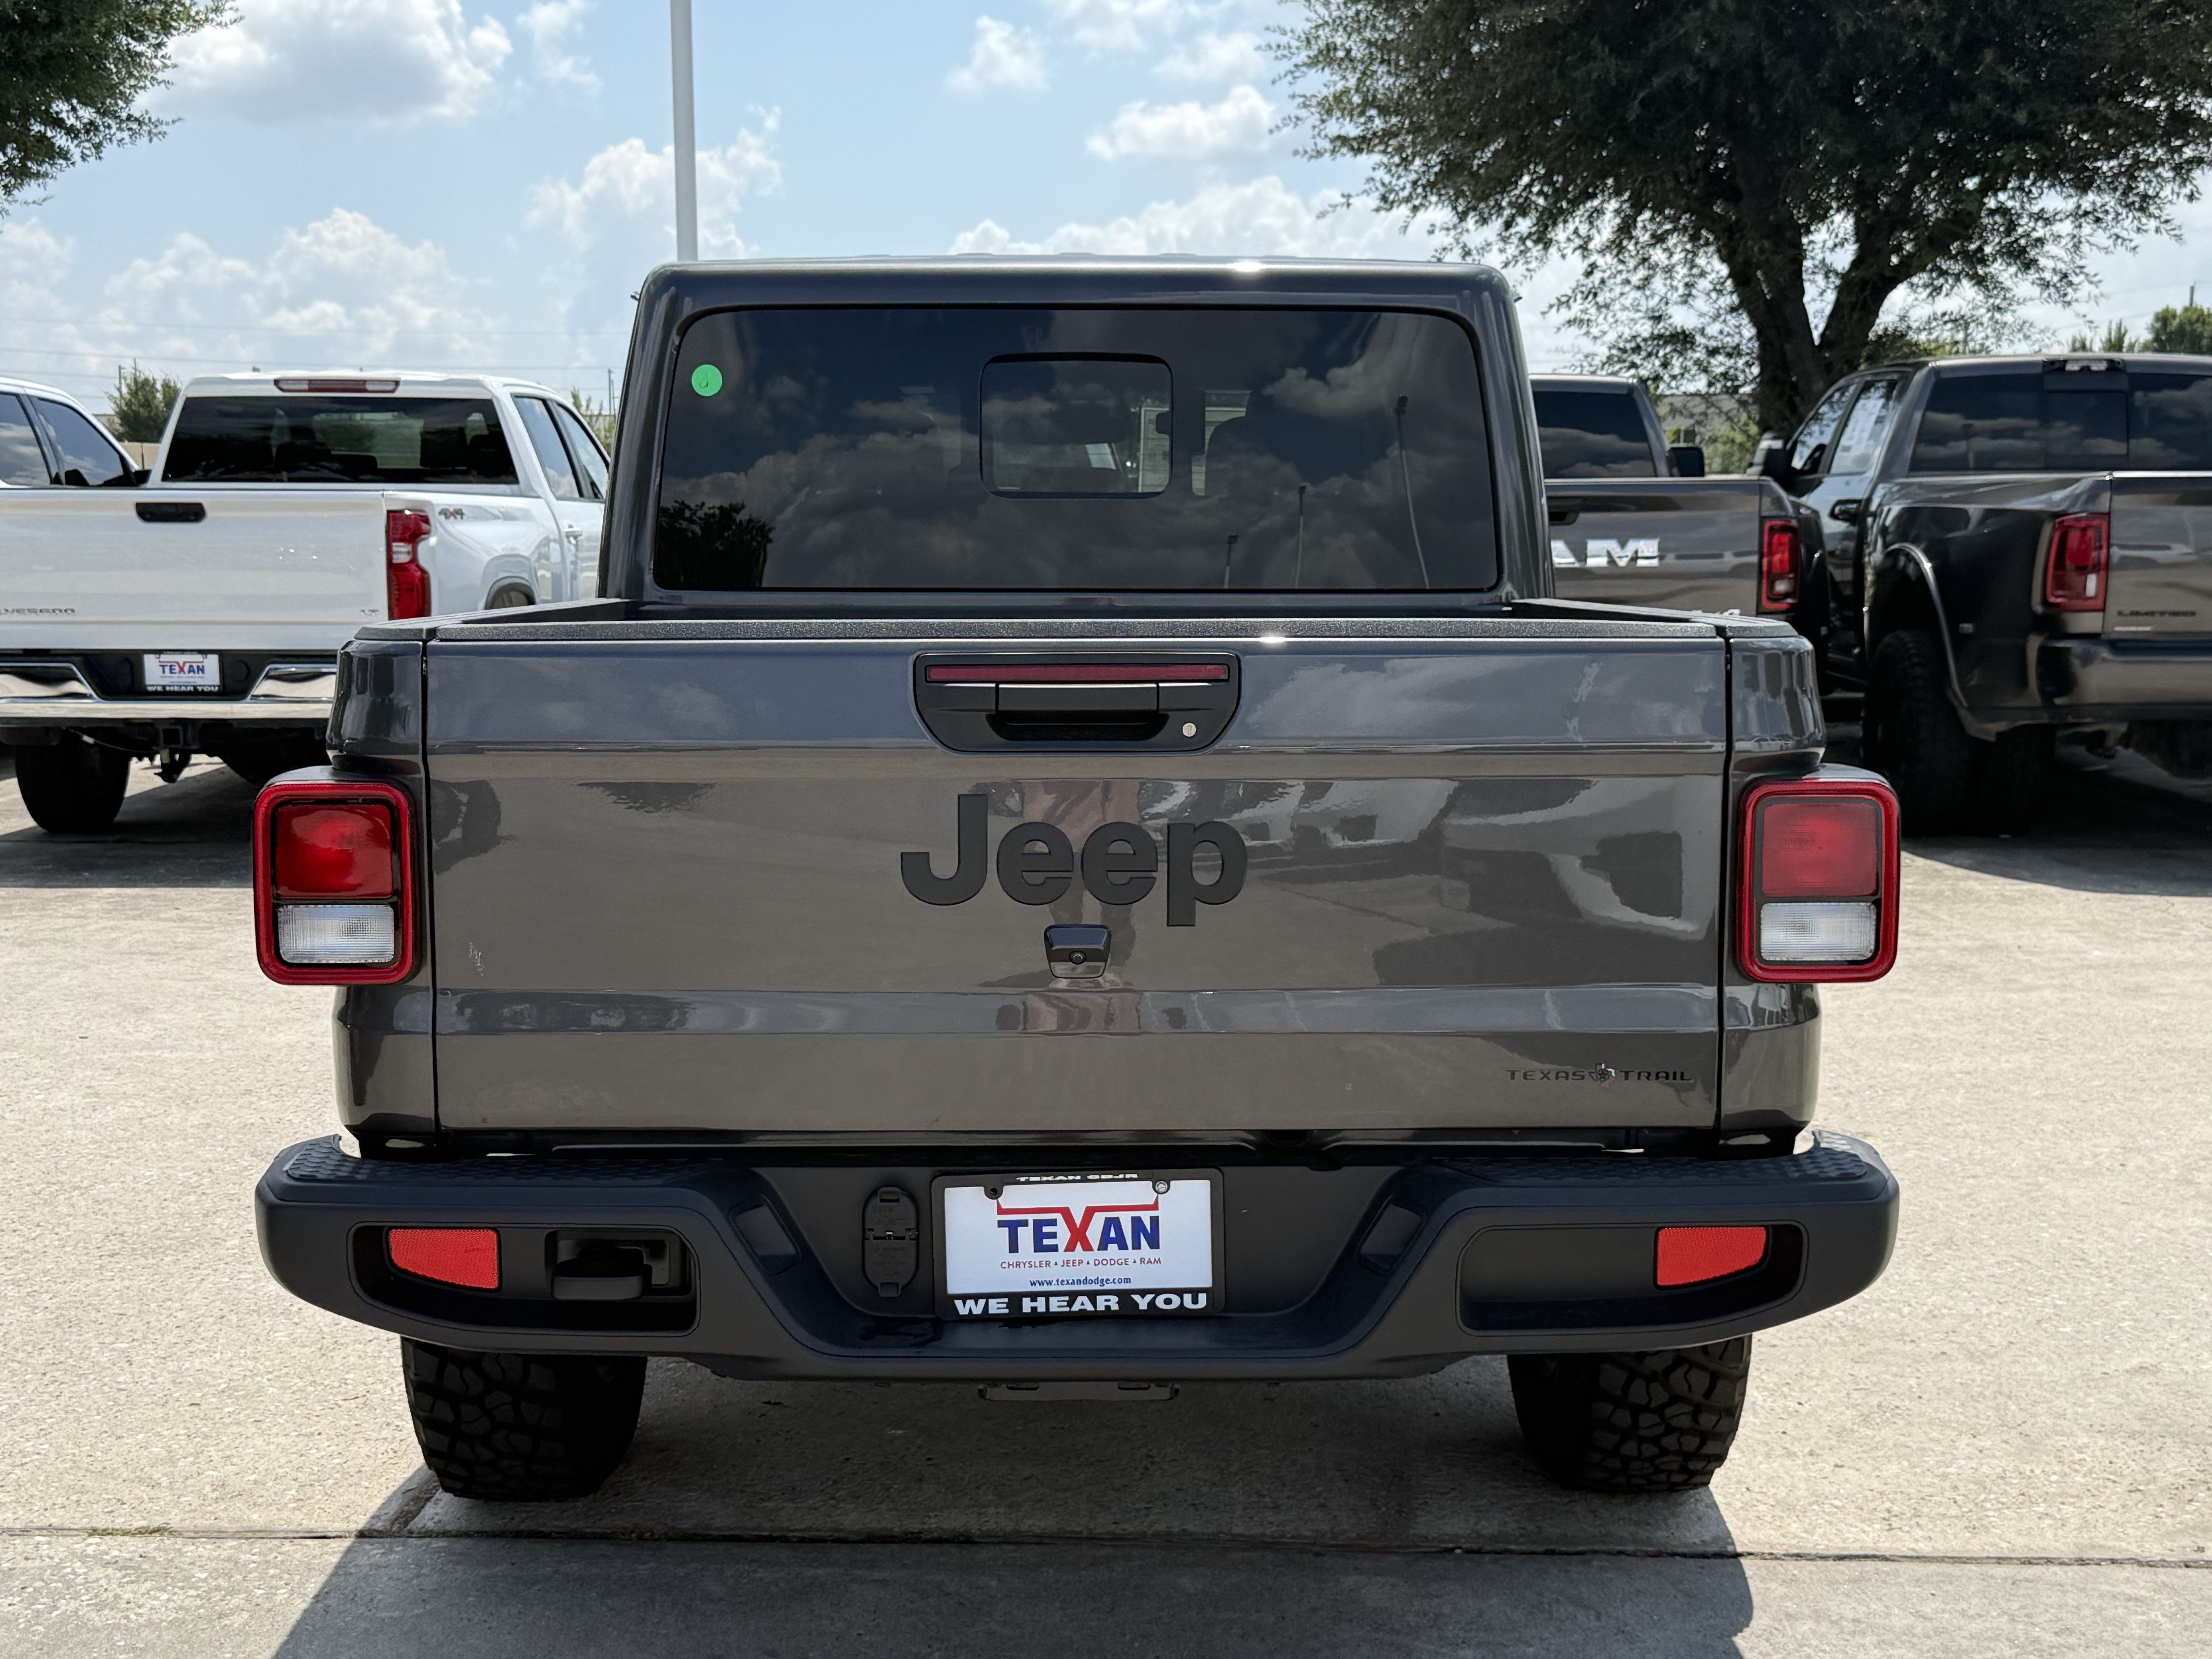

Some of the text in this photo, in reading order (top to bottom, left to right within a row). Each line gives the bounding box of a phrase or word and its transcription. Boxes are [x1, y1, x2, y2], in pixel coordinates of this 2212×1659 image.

[1551, 538, 1660, 567] AM
[159, 661, 205, 675] TEXAN
[900, 794, 1248, 927] Jeep
[1505, 1070, 1693, 1081] TEXAS TRAIL
[997, 1205, 1160, 1254] TEXAN
[1000, 1260, 1051, 1269] CHRYSLER
[1094, 1258, 1130, 1266] DODGE
[1029, 1276, 1132, 1287] www.texandodge.com
[954, 1293, 1207, 1315] WE HEAR YOU
